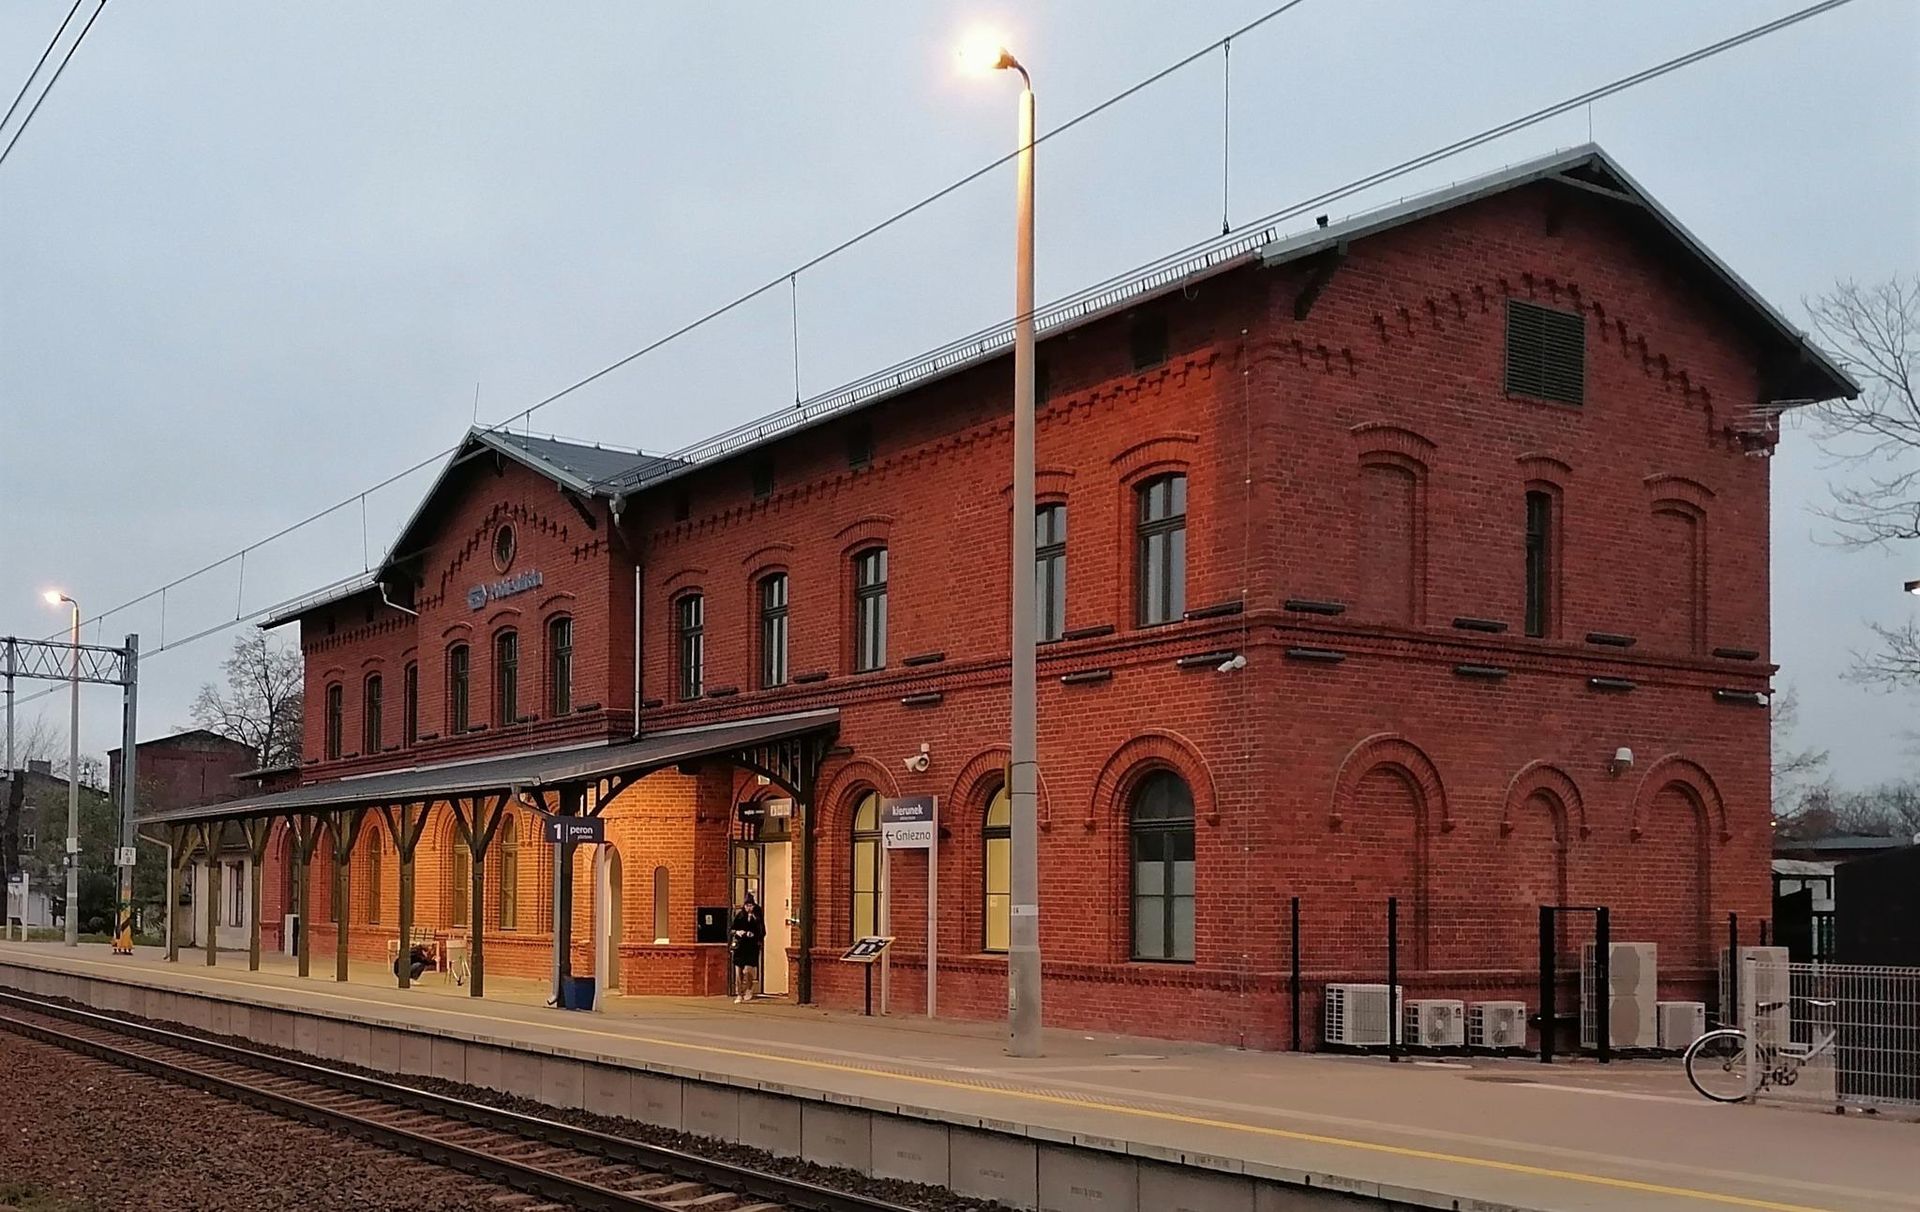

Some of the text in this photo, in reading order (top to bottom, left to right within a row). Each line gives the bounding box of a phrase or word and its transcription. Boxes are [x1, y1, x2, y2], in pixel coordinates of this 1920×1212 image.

[892, 804, 923, 816] kierunek
[553, 823, 562, 840] 1
[570, 826, 593, 835] peron
[895, 829, 931, 841] Gniezno
